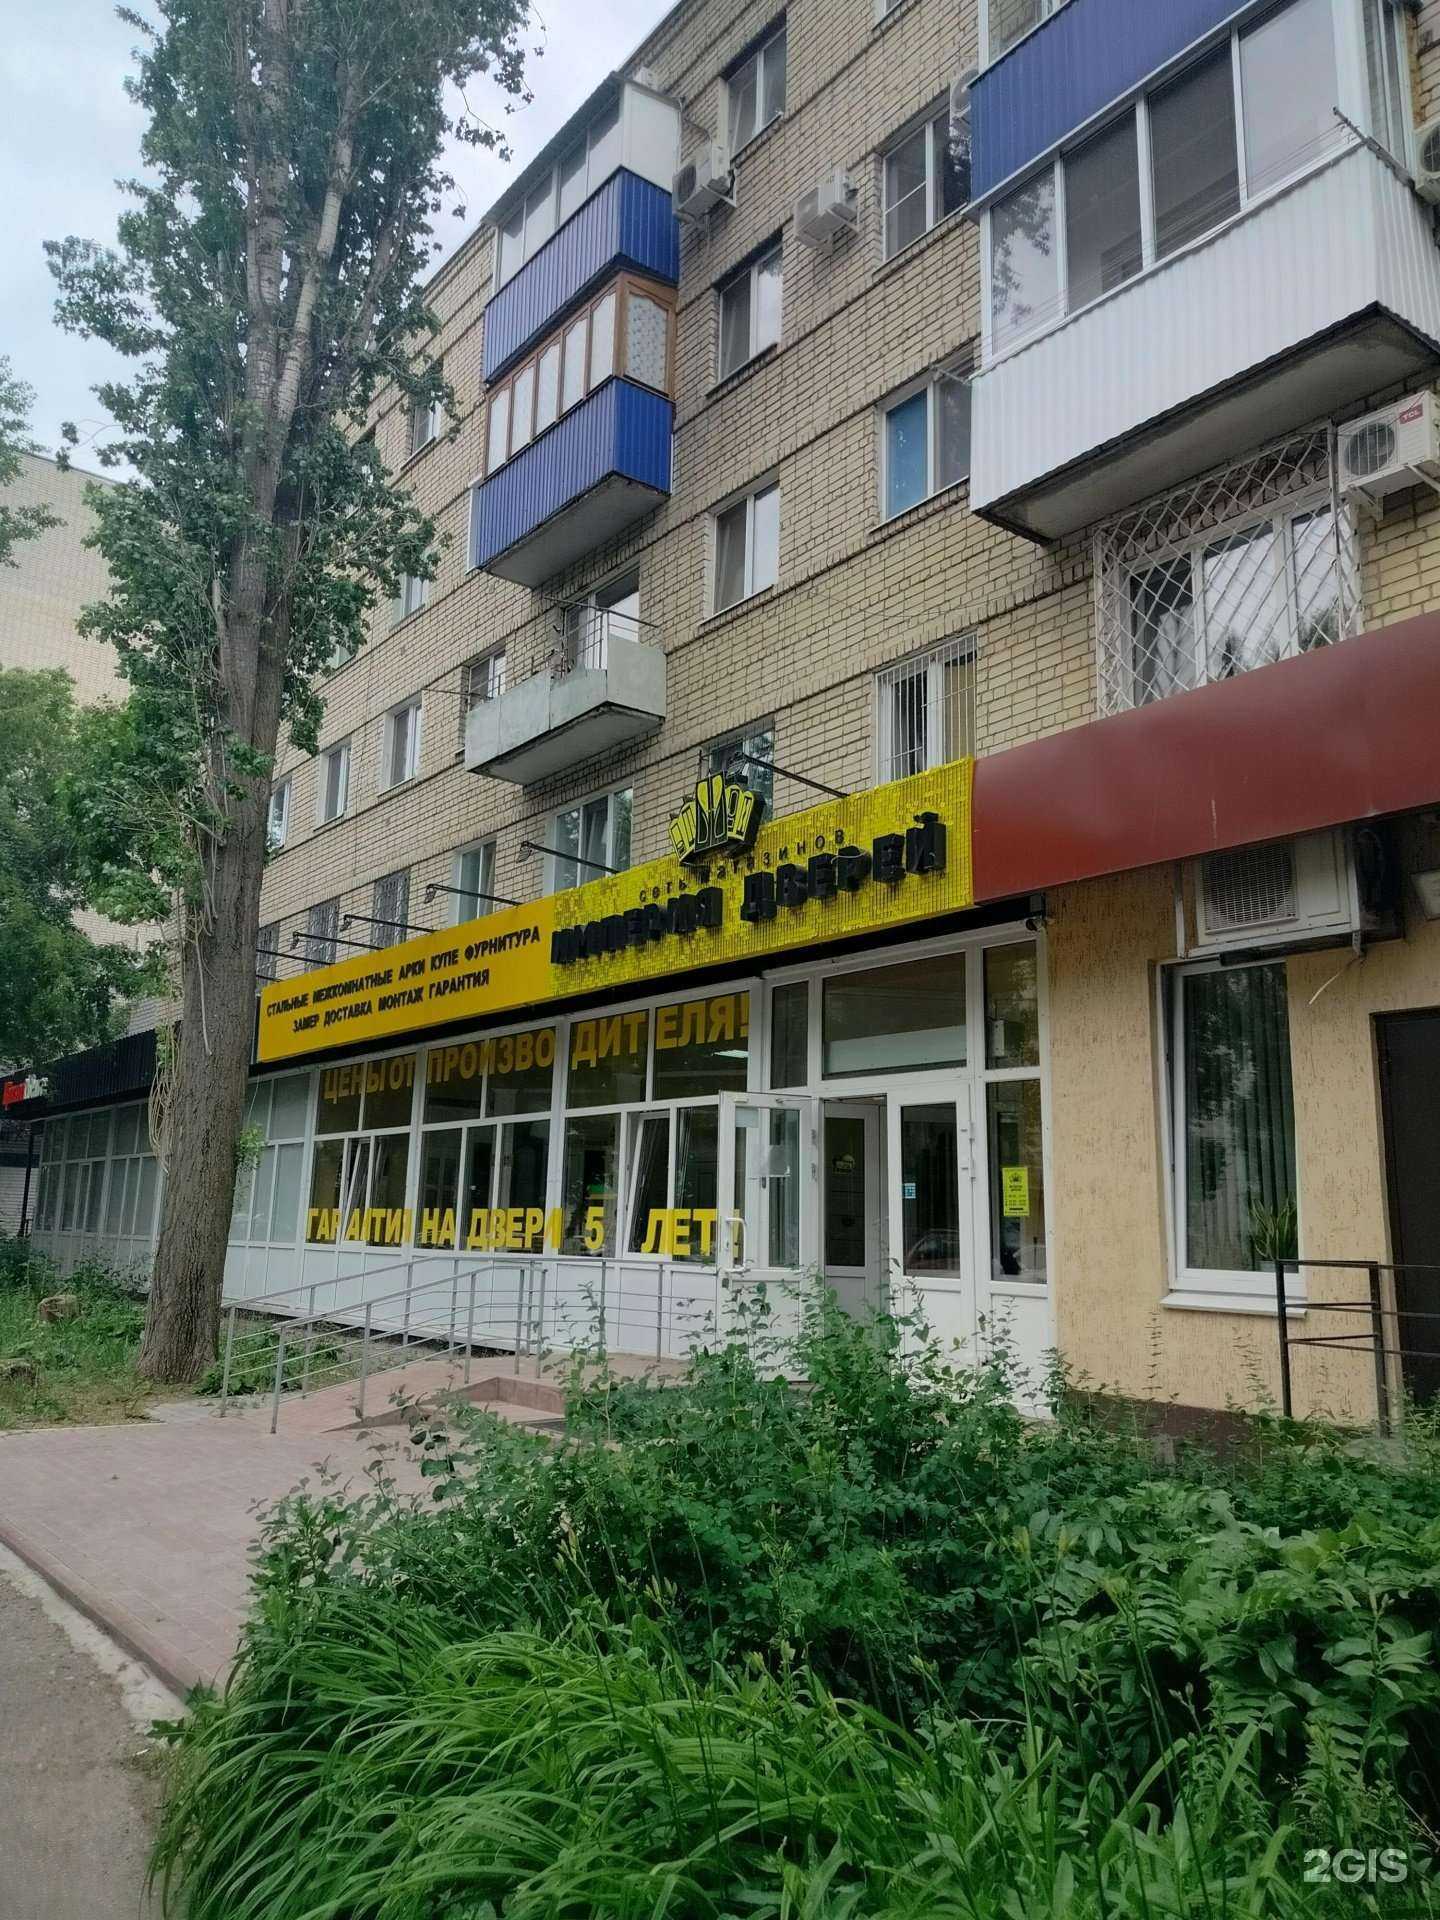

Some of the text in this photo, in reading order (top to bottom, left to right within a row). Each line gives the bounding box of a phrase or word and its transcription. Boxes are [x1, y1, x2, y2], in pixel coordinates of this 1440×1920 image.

[739, 811, 947, 922] ДВЕРЕЙ
[266, 925, 540, 1017] СТАЛЬНЫЕ МЕЖКОМНАТНЫЕ АРКИ КУПЕ ФУРНИТУРА
[292, 968, 490, 1033] ЗАМЕР ДОСТАВКА МОНТАЖ ГАРАНТИЯ
[324, 1059, 386, 1104] ЦЕНЫ
[420, 1207, 456, 1244] НА
[466, 1207, 563, 1252] ДВЕРИ
[584, 1206, 605, 1250] 5
